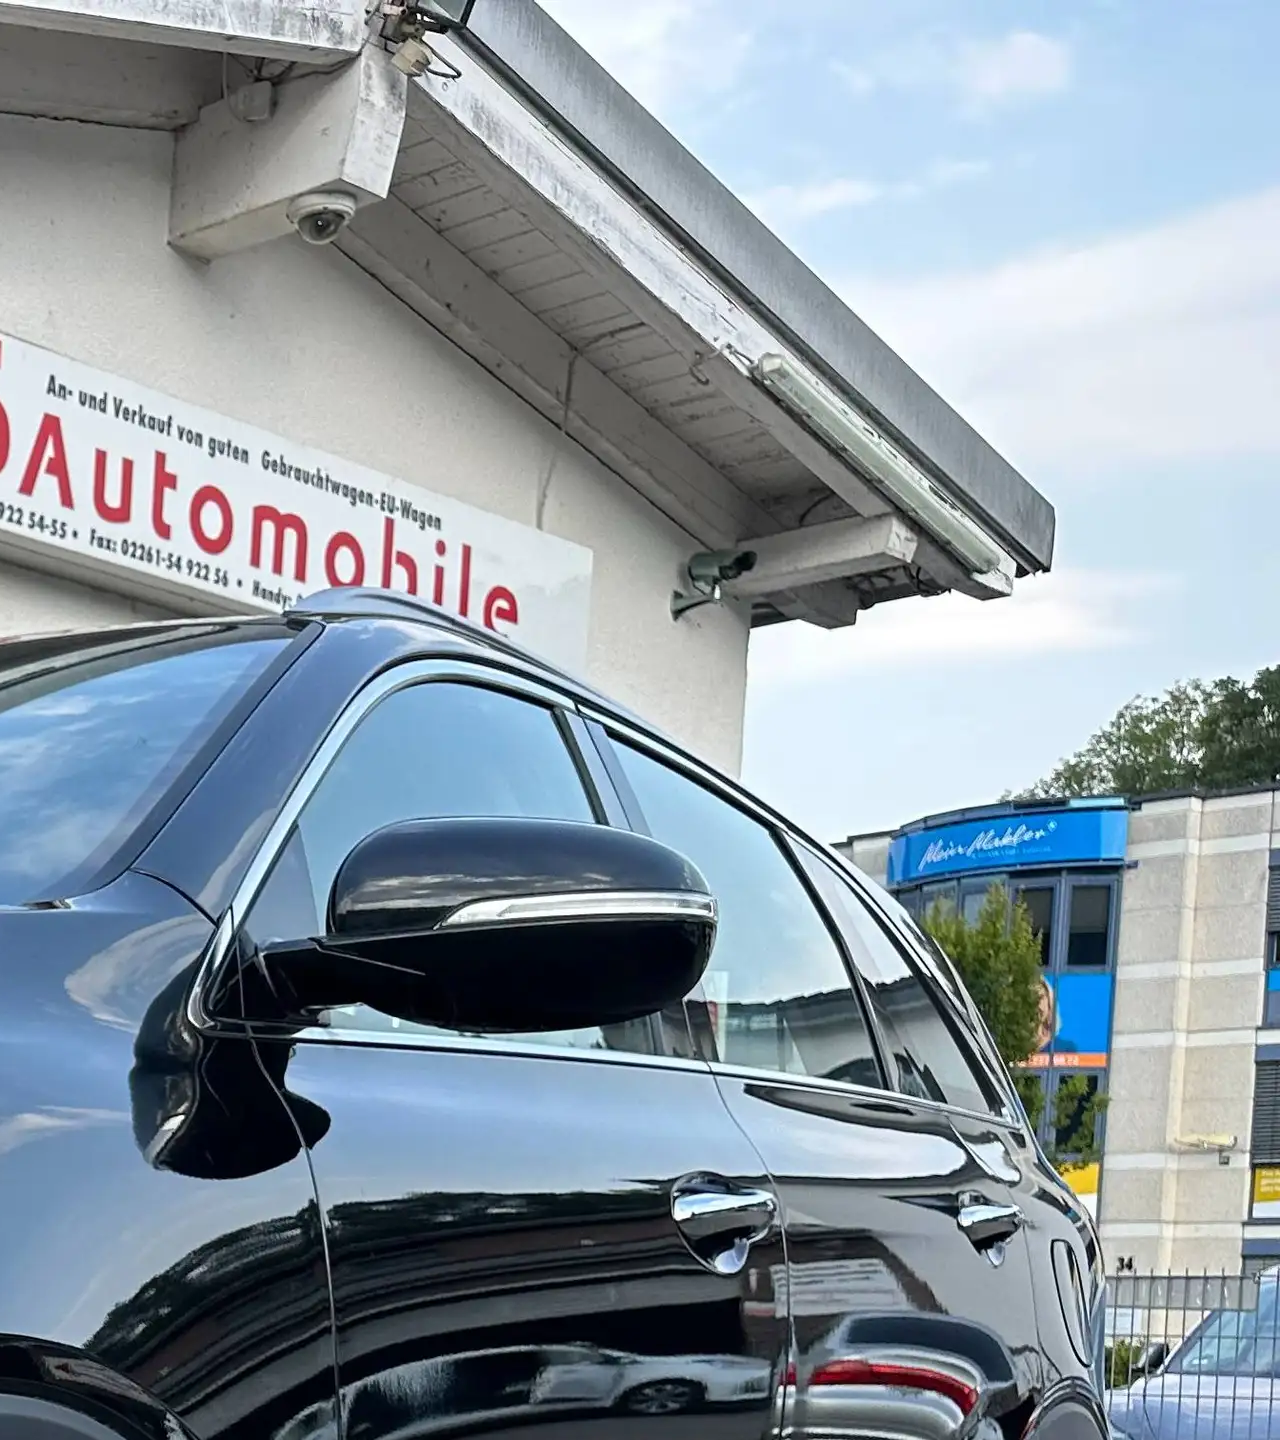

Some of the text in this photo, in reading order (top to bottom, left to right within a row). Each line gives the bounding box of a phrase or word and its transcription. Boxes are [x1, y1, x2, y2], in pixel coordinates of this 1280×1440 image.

[46, 374, 74, 401] An-
[78, 390, 108, 414] und
[113, 396, 173, 437] Verkauf
[177, 422, 203, 449] von
[208, 436, 250, 473] guten
[89, 528, 118, 553] Fax:
[120, 537, 183, 575] 02261-54
[187, 559, 210, 582] 922
[213, 568, 229, 588] 56
